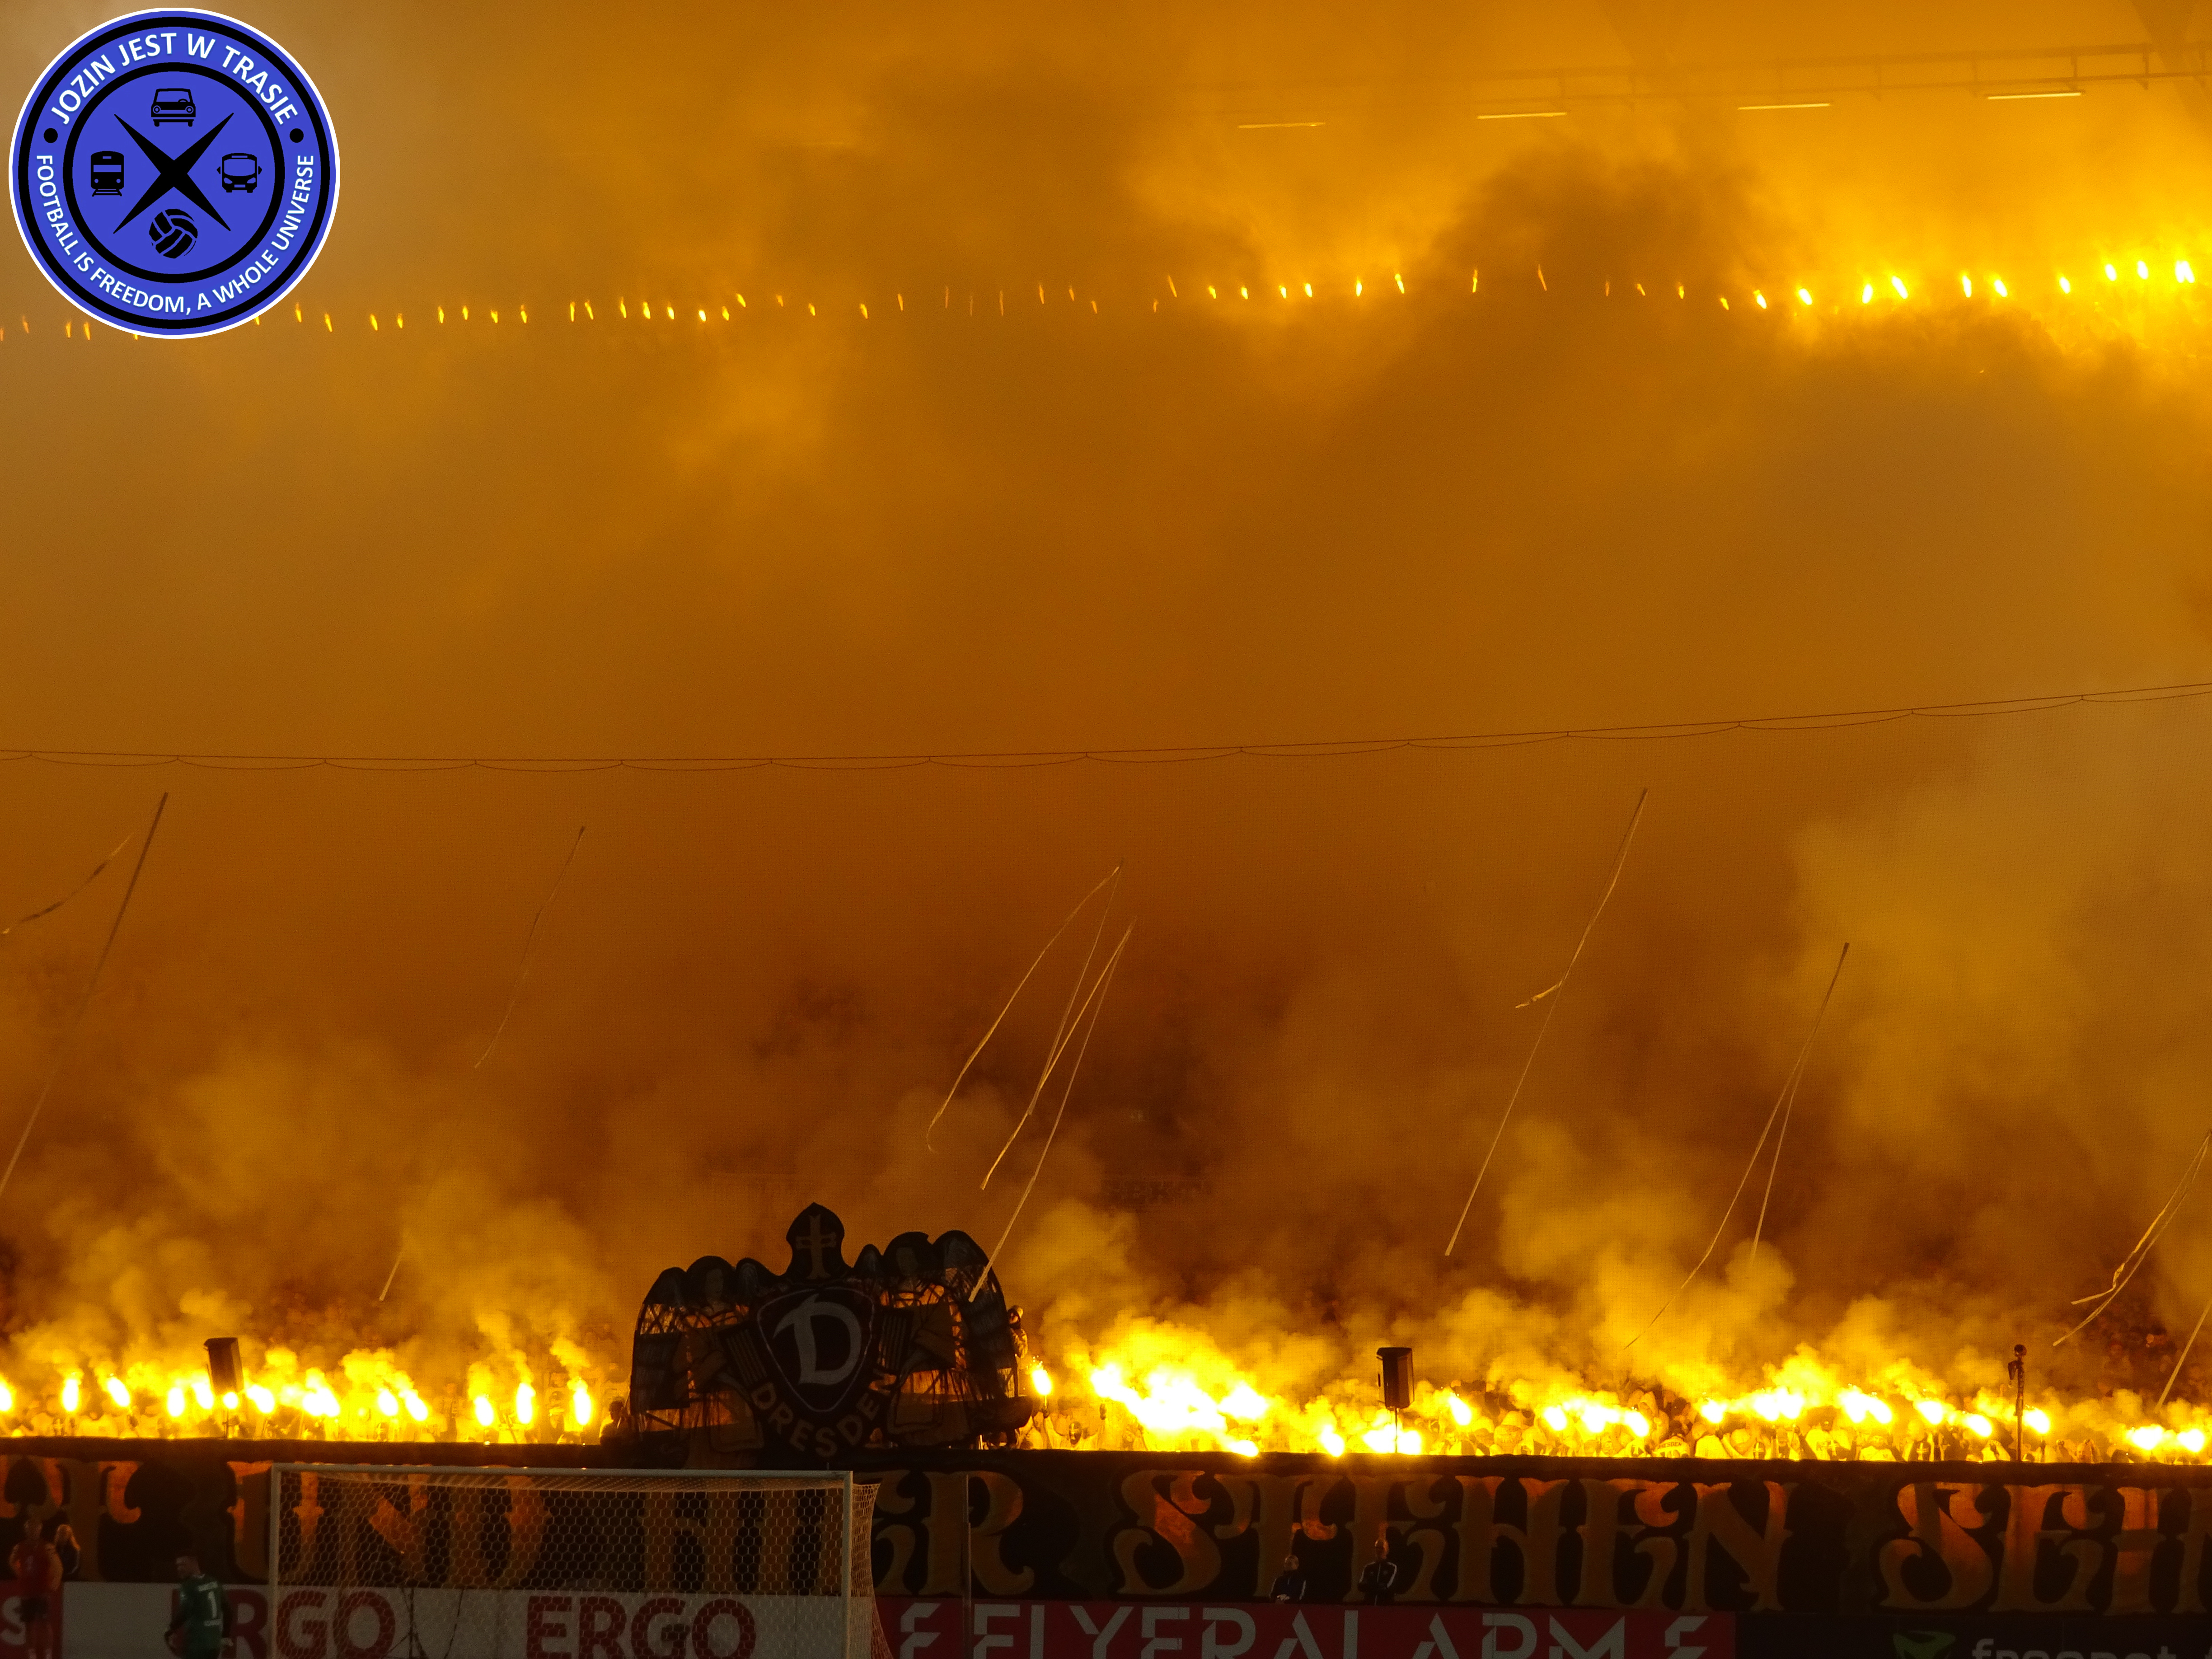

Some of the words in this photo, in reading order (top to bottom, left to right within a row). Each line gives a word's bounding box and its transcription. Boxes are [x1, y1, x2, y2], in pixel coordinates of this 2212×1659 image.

[773, 1293, 862, 1385] D
[750, 1359, 897, 1458] DRESDEN
[1113, 1469, 1800, 1612] STEHEN
[171, 1589, 395, 1659] RGO
[207, 1591, 217, 1618] 1
[526, 1596, 756, 1659] ERGO
